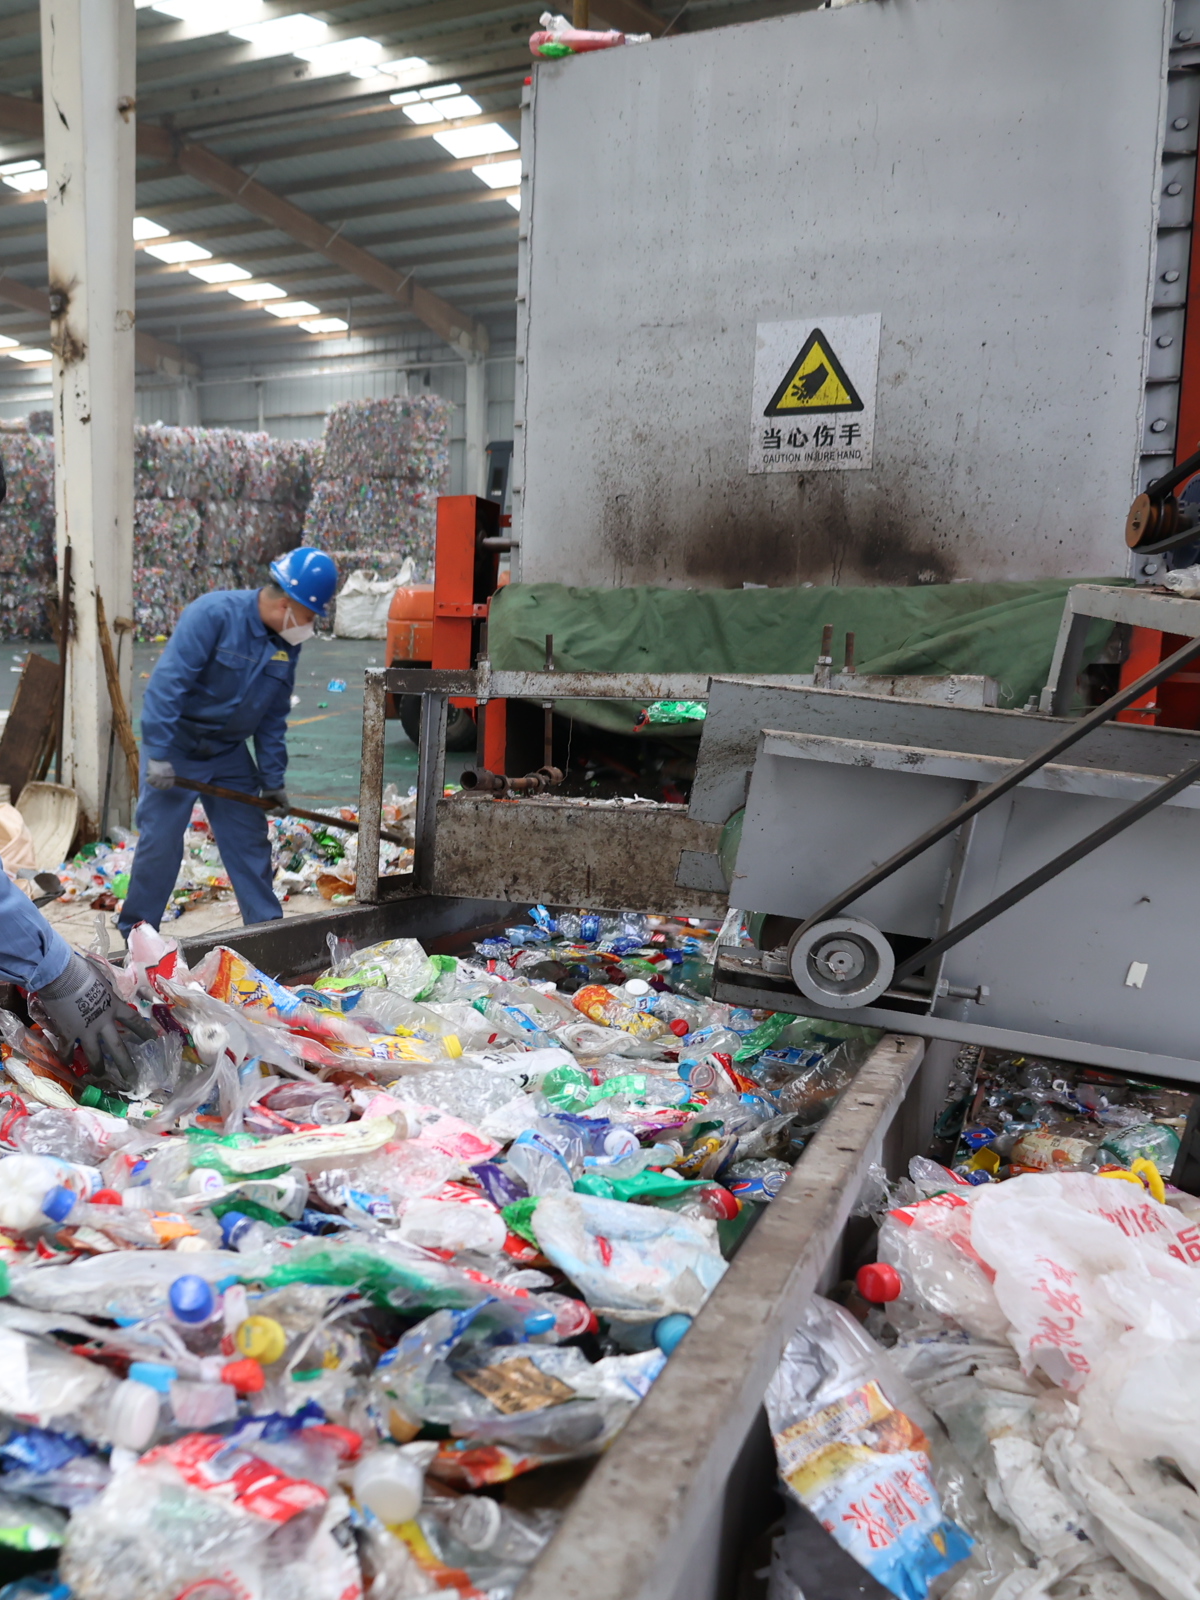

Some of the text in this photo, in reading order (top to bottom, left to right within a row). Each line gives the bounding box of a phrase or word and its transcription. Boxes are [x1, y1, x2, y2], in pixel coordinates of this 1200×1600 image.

[762, 423, 862, 450] 当心伤手
[804, 451, 836, 462] INJURE
[836, 450, 861, 460] HAND
